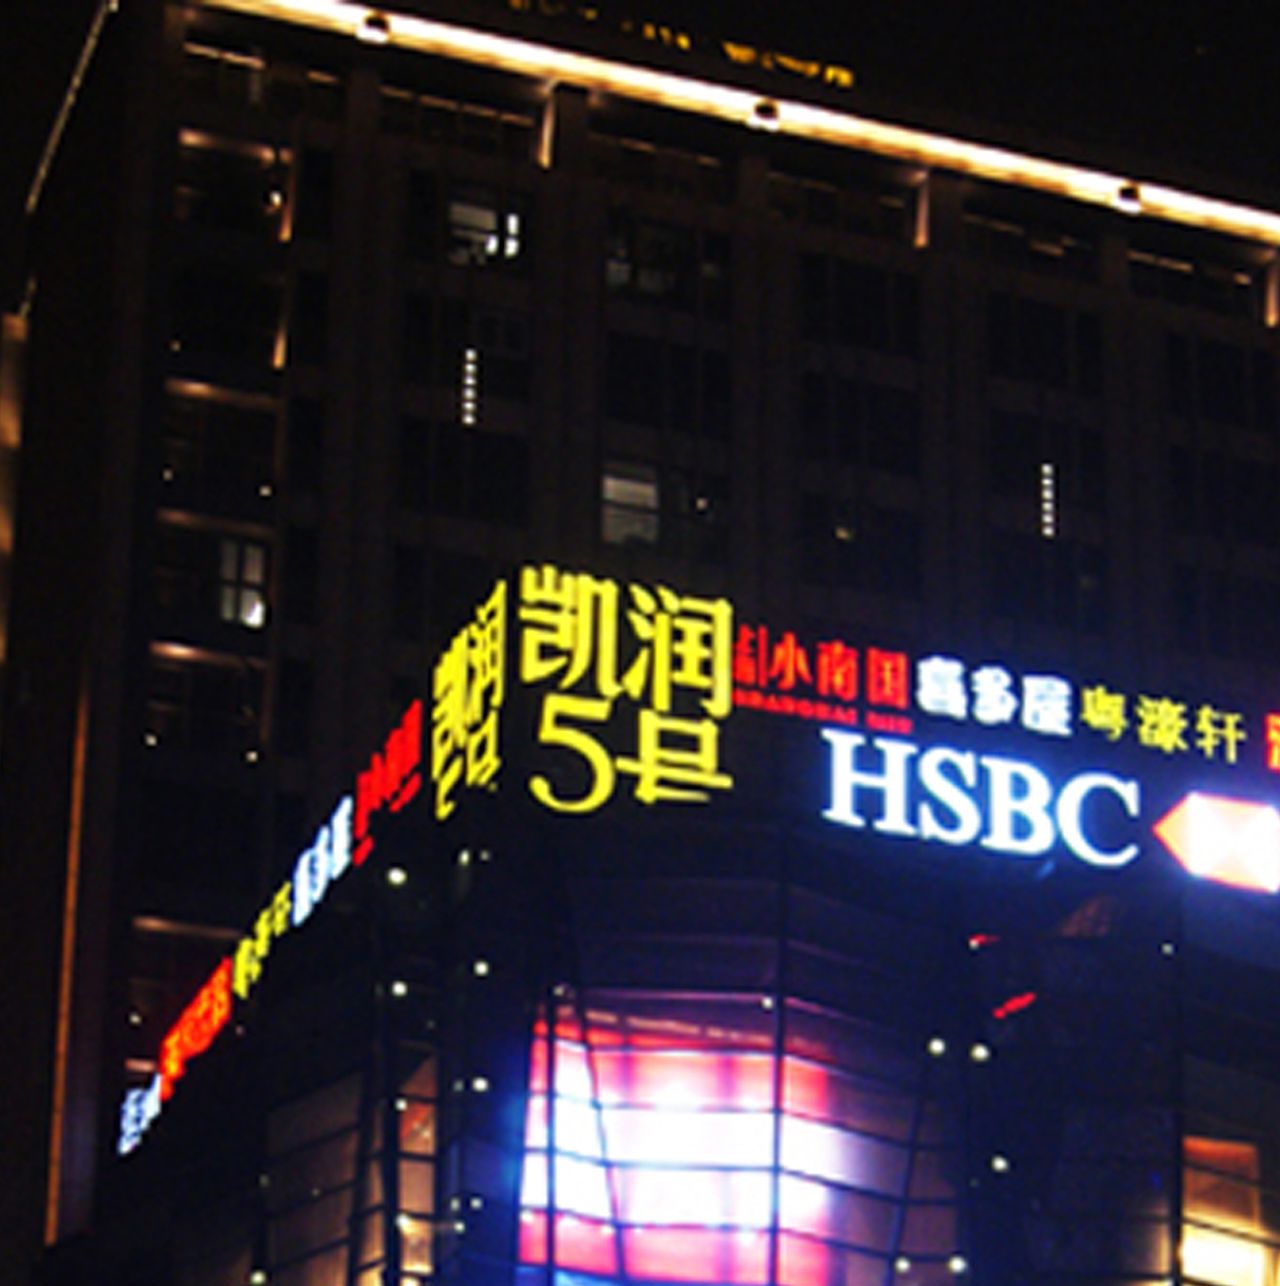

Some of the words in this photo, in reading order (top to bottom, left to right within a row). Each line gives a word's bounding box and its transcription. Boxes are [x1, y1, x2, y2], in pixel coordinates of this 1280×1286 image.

[520, 565, 733, 717] 凯润
[529, 692, 733, 813] 5号
[820, 727, 1141, 866] HSBC
